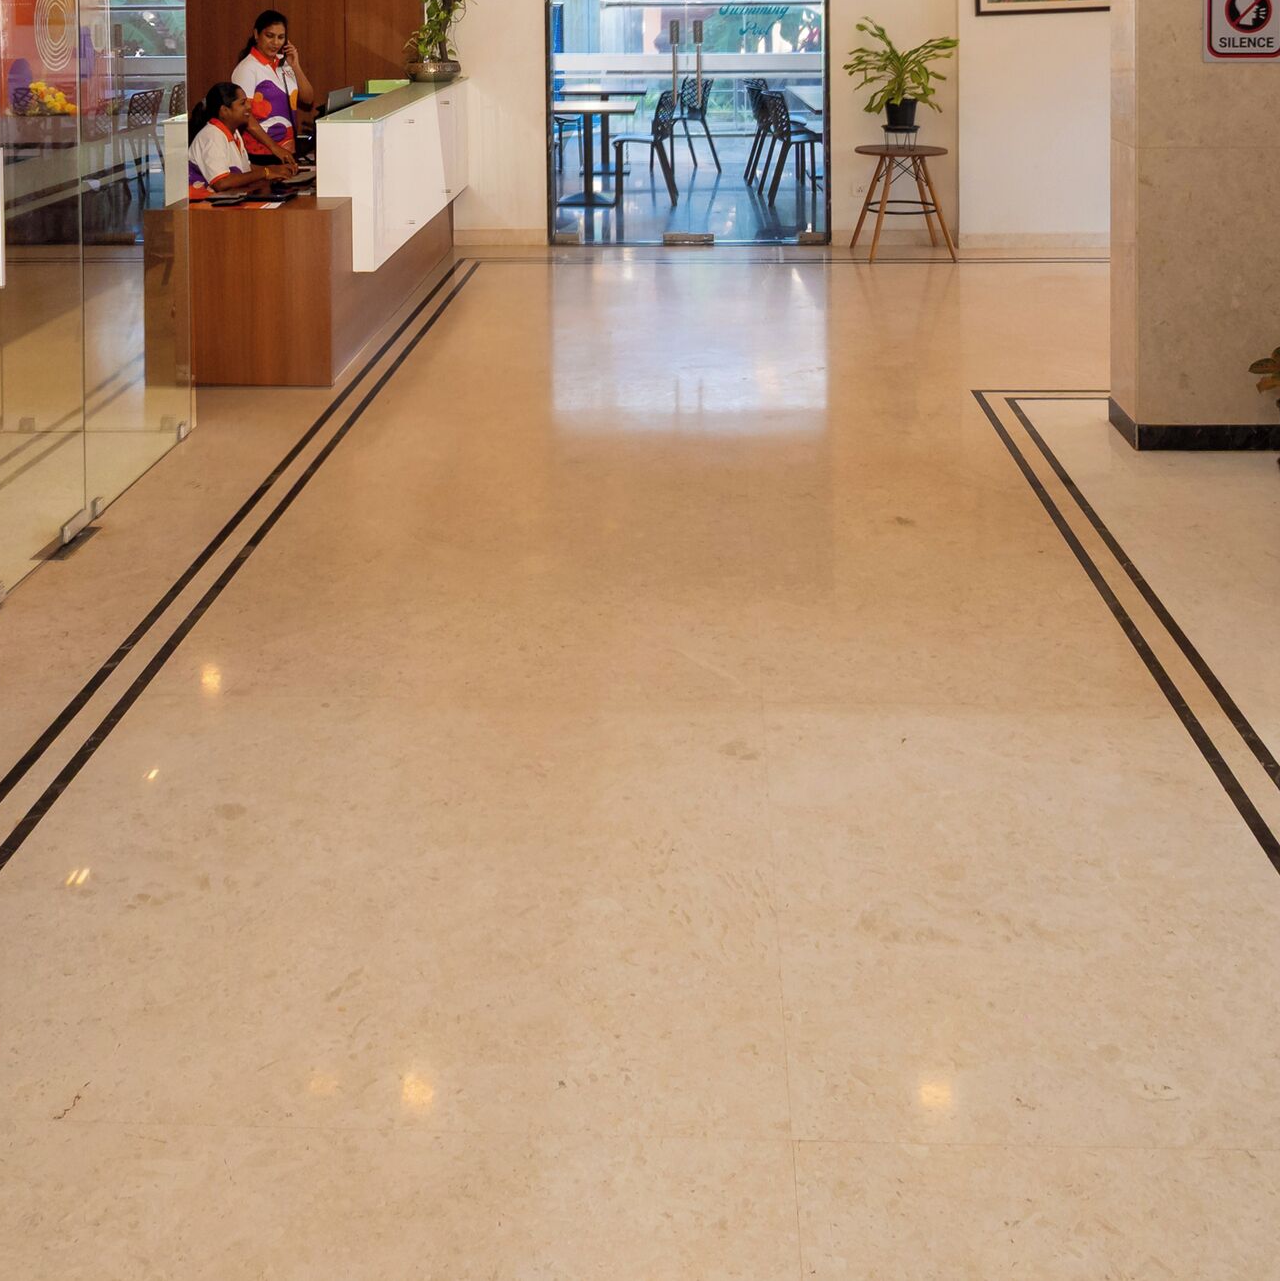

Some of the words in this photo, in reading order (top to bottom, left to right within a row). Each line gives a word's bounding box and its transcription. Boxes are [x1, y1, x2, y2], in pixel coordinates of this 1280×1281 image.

[719, 2, 791, 20] Swimming
[739, 20, 777, 36] Pool
[1218, 36, 1275, 49] SILENCE
